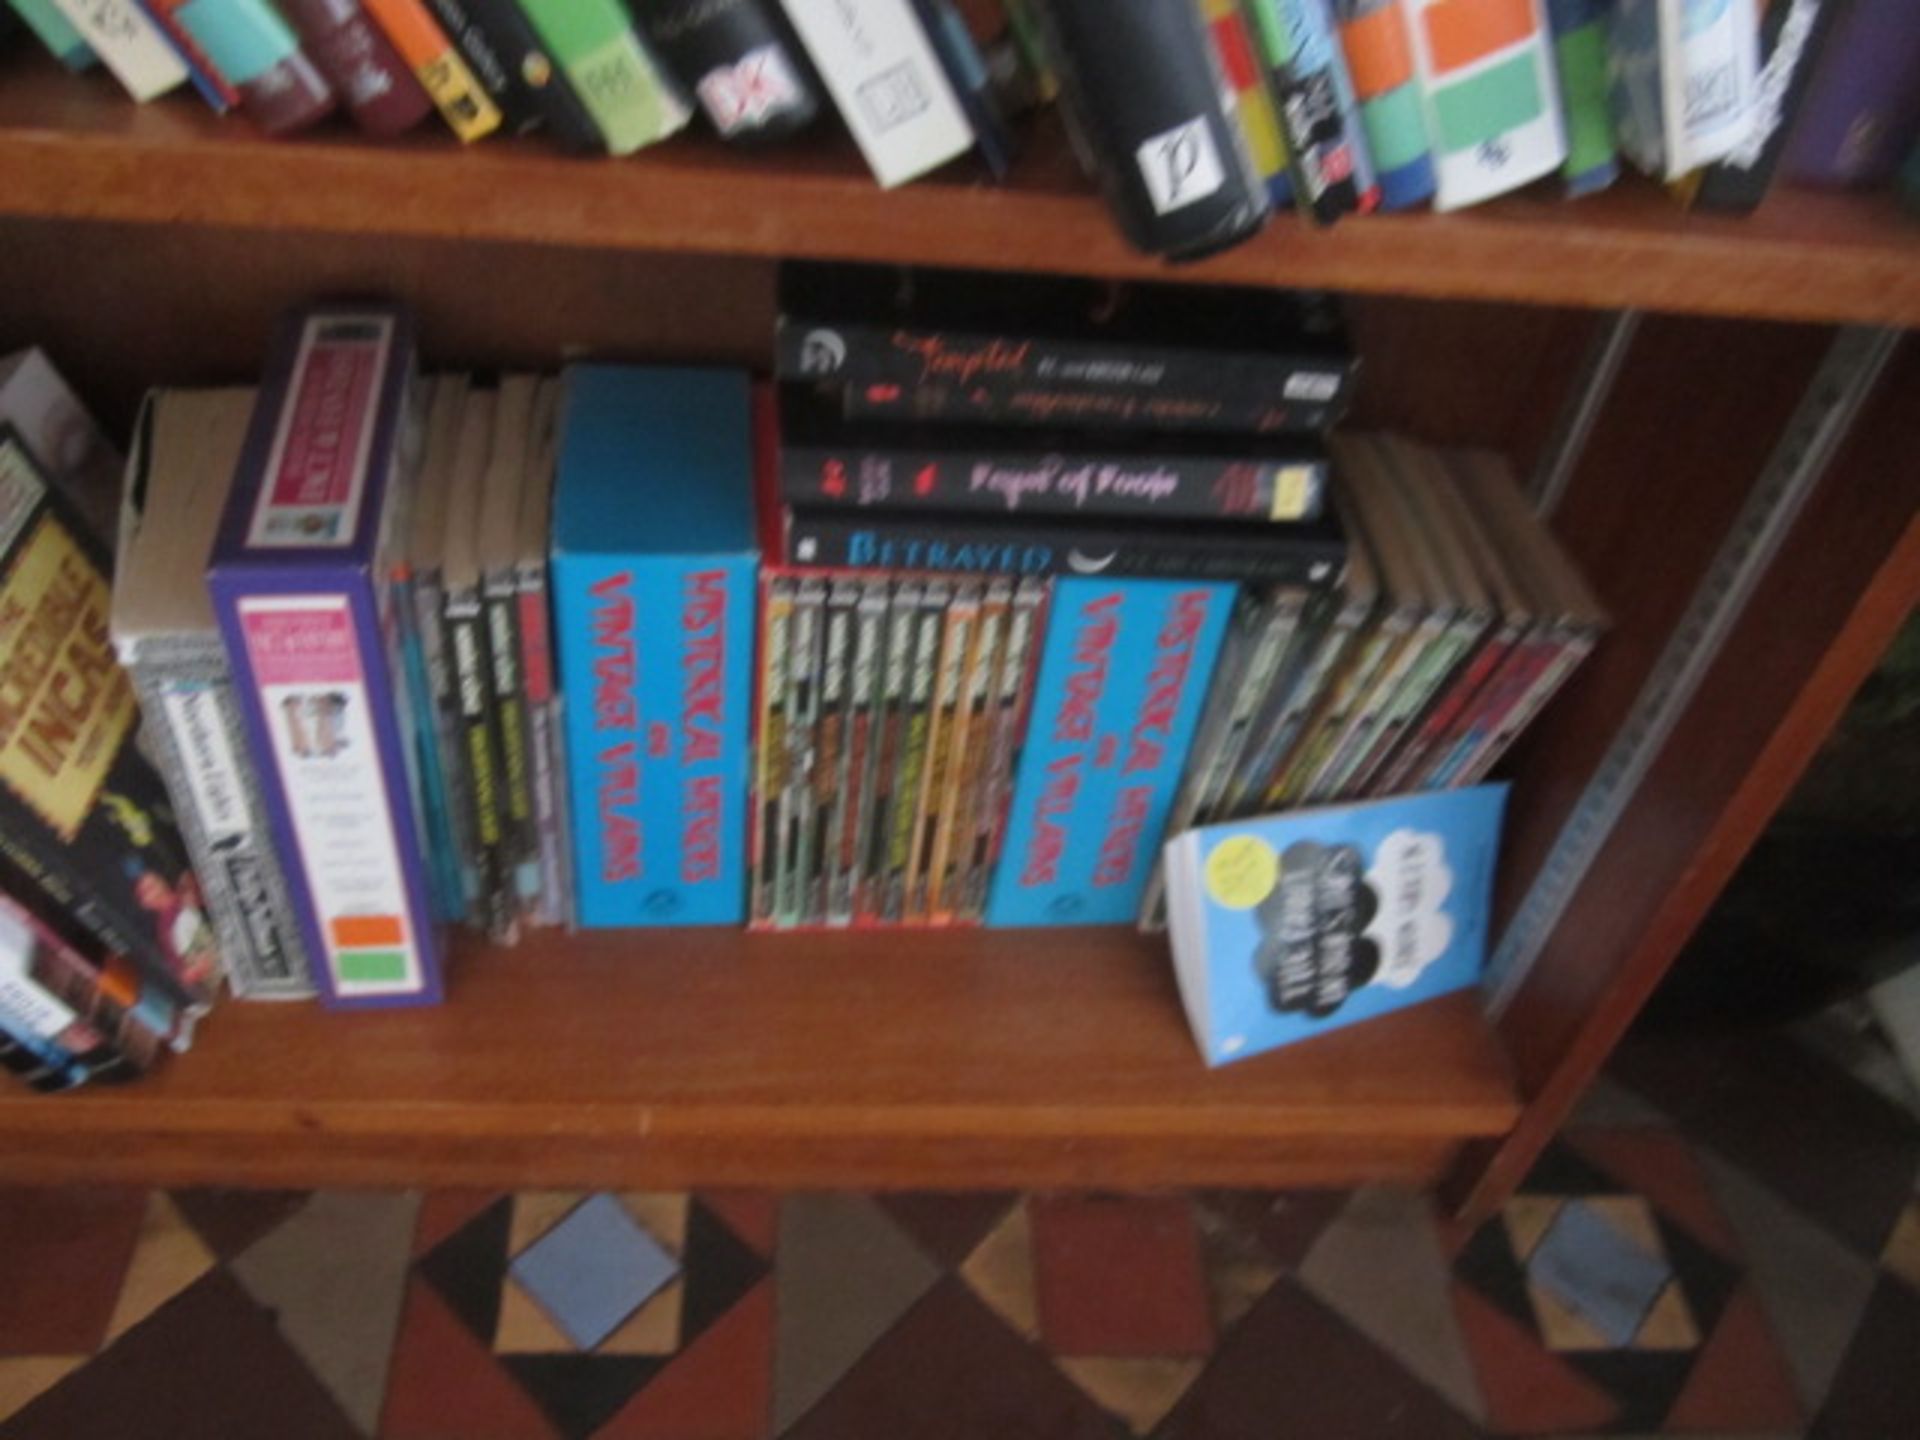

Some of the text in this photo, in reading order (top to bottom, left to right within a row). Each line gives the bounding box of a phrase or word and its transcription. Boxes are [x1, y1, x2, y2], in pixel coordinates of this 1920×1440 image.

[892, 332, 1031, 386] Tempted
[1057, 463, 1096, 507] of
[587, 570, 643, 883] VINTAGE VILLAINS
